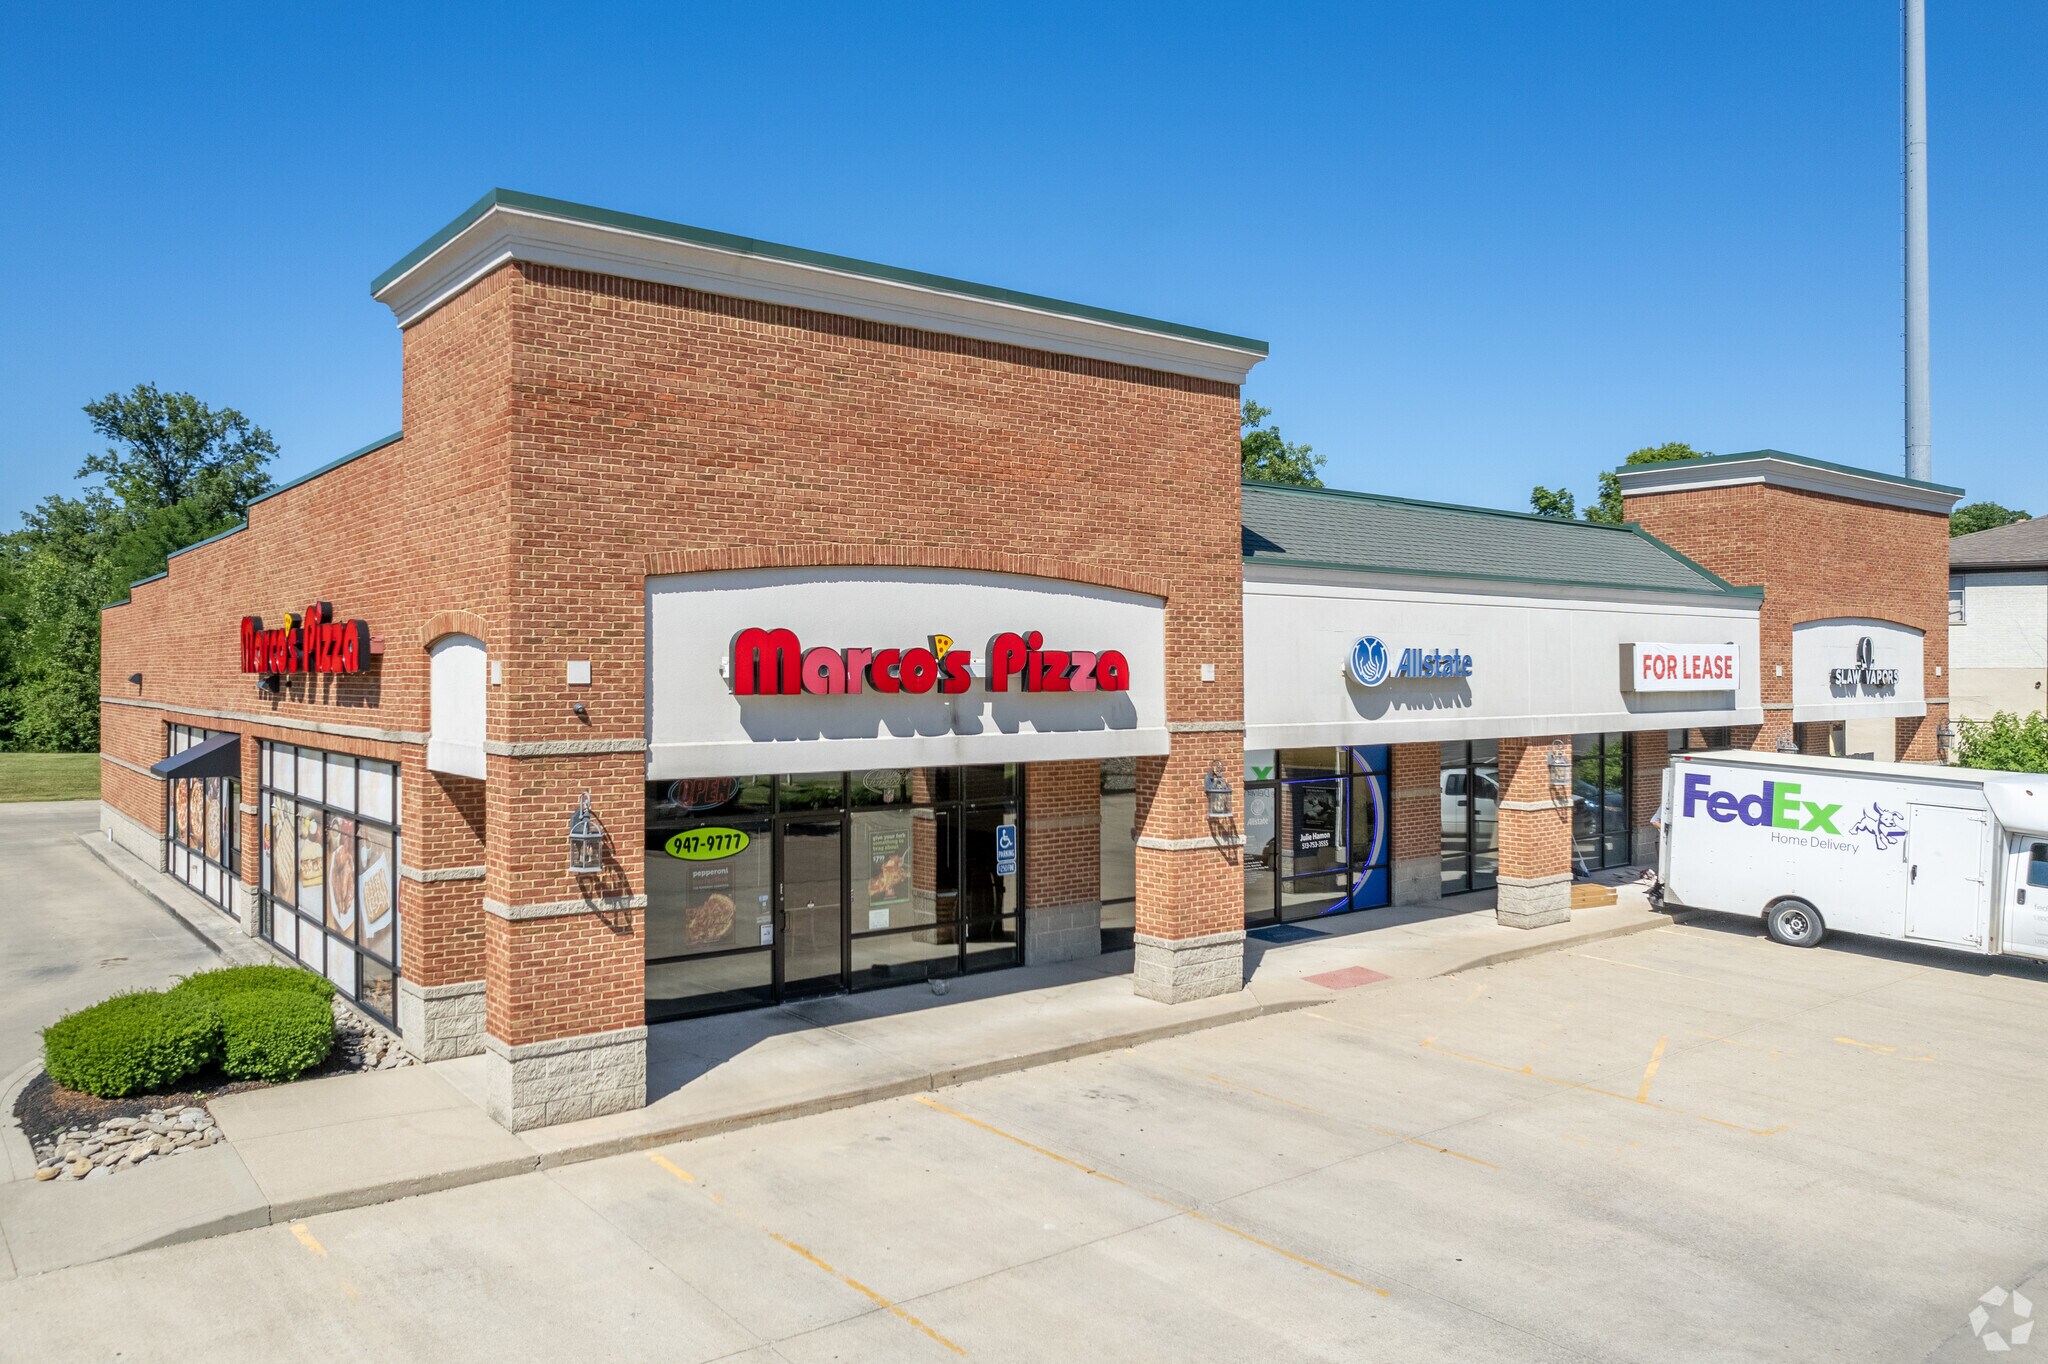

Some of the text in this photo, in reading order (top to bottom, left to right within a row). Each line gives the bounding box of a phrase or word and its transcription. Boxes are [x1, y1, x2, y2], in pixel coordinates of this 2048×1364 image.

[241, 600, 362, 674] Marco's Pizza
[731, 627, 1130, 695] Marco's Pizza
[1395, 647, 1473, 678] Allstate
[1642, 654, 1733, 680] FOR LEASE
[1835, 668, 1861, 685] SLAW
[677, 777, 733, 804] OPEN
[1682, 772, 1845, 837] FedEx
[674, 833, 742, 855] 947-9777
[1770, 831, 1860, 855] Home Delivery
[692, 867, 729, 878] pepperoni
